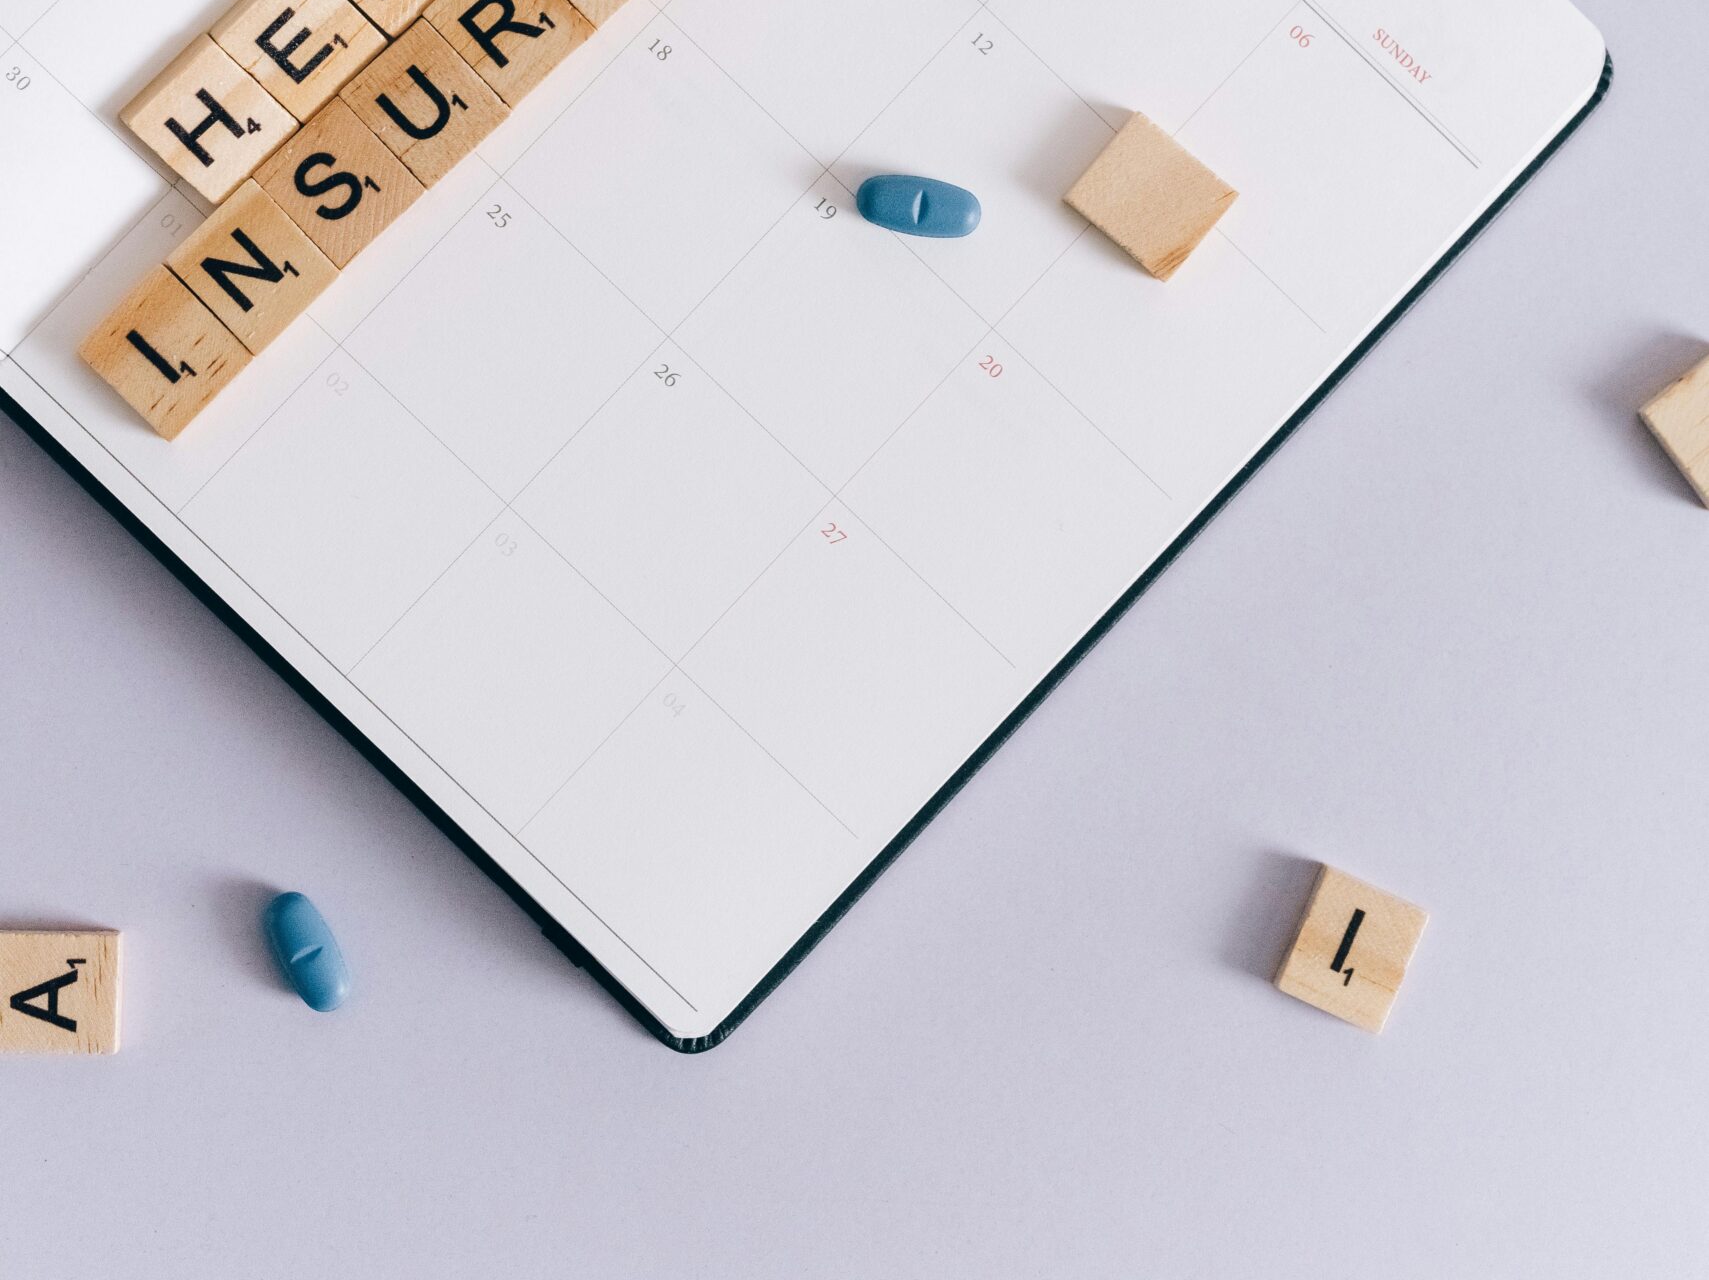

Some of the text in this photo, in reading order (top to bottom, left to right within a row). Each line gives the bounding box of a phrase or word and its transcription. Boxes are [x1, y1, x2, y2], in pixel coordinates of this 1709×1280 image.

[970, 31, 995, 56] 12
[1288, 24, 1315, 49] 06
[648, 37, 673, 62] 18
[1371, 27, 1433, 86] SUNDAY
[5, 65, 32, 91] 30
[487, 203, 512, 229] 25
[813, 196, 838, 221] 19
[160, 213, 184, 239] 01
[654, 363, 681, 388] 26
[978, 354, 1004, 379] 20
[325, 372, 350, 397] 02
[493, 532, 518, 557] 03
[820, 521, 847, 546] 27
[661, 692, 686, 718] 04
[1330, 908, 1366, 973] I
[9, 969, 79, 1033] A
